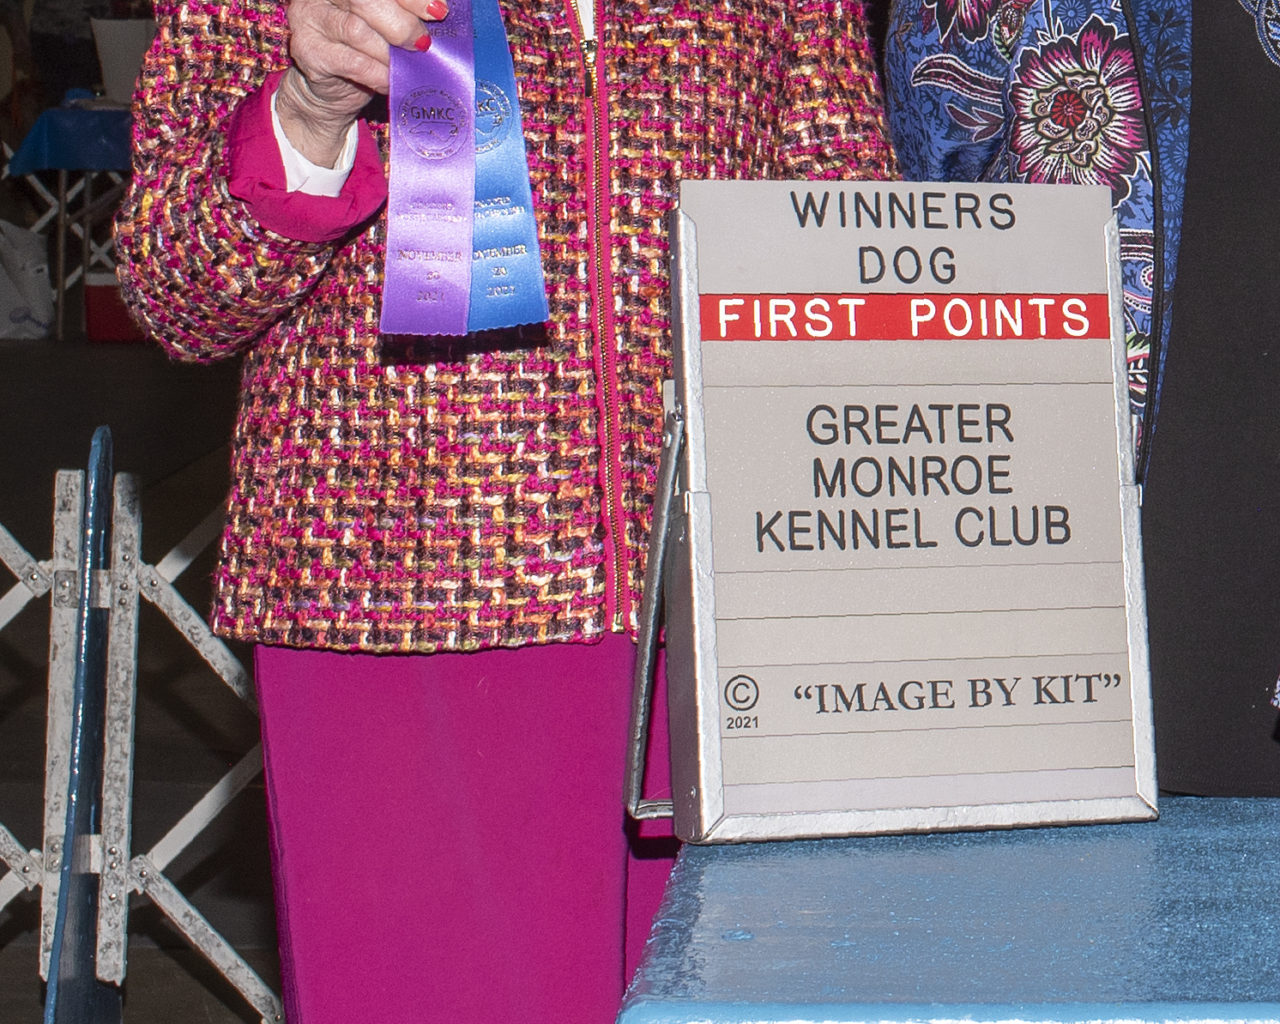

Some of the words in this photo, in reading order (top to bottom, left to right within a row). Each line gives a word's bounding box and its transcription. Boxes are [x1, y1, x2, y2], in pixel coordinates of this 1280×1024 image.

[410, 106, 455, 121] GMKC
[476, 98, 496, 112] KC
[790, 190, 1016, 230] WINNERS
[397, 249, 463, 263] NOVEMBER
[472, 244, 528, 262] OVEMBER
[858, 245, 956, 284] DOG
[718, 297, 866, 338] FIRST
[910, 297, 1090, 337] POINTS
[806, 403, 1015, 445] GREATER
[813, 454, 1013, 498] MONROE
[755, 507, 938, 553] KENNEL
[954, 505, 1072, 548] CLUB
[794, 680, 955, 714] “IMAGE
[967, 677, 1022, 708] BY
[1031, 672, 1121, 705] KIT”
[726, 715, 759, 730] 2021
